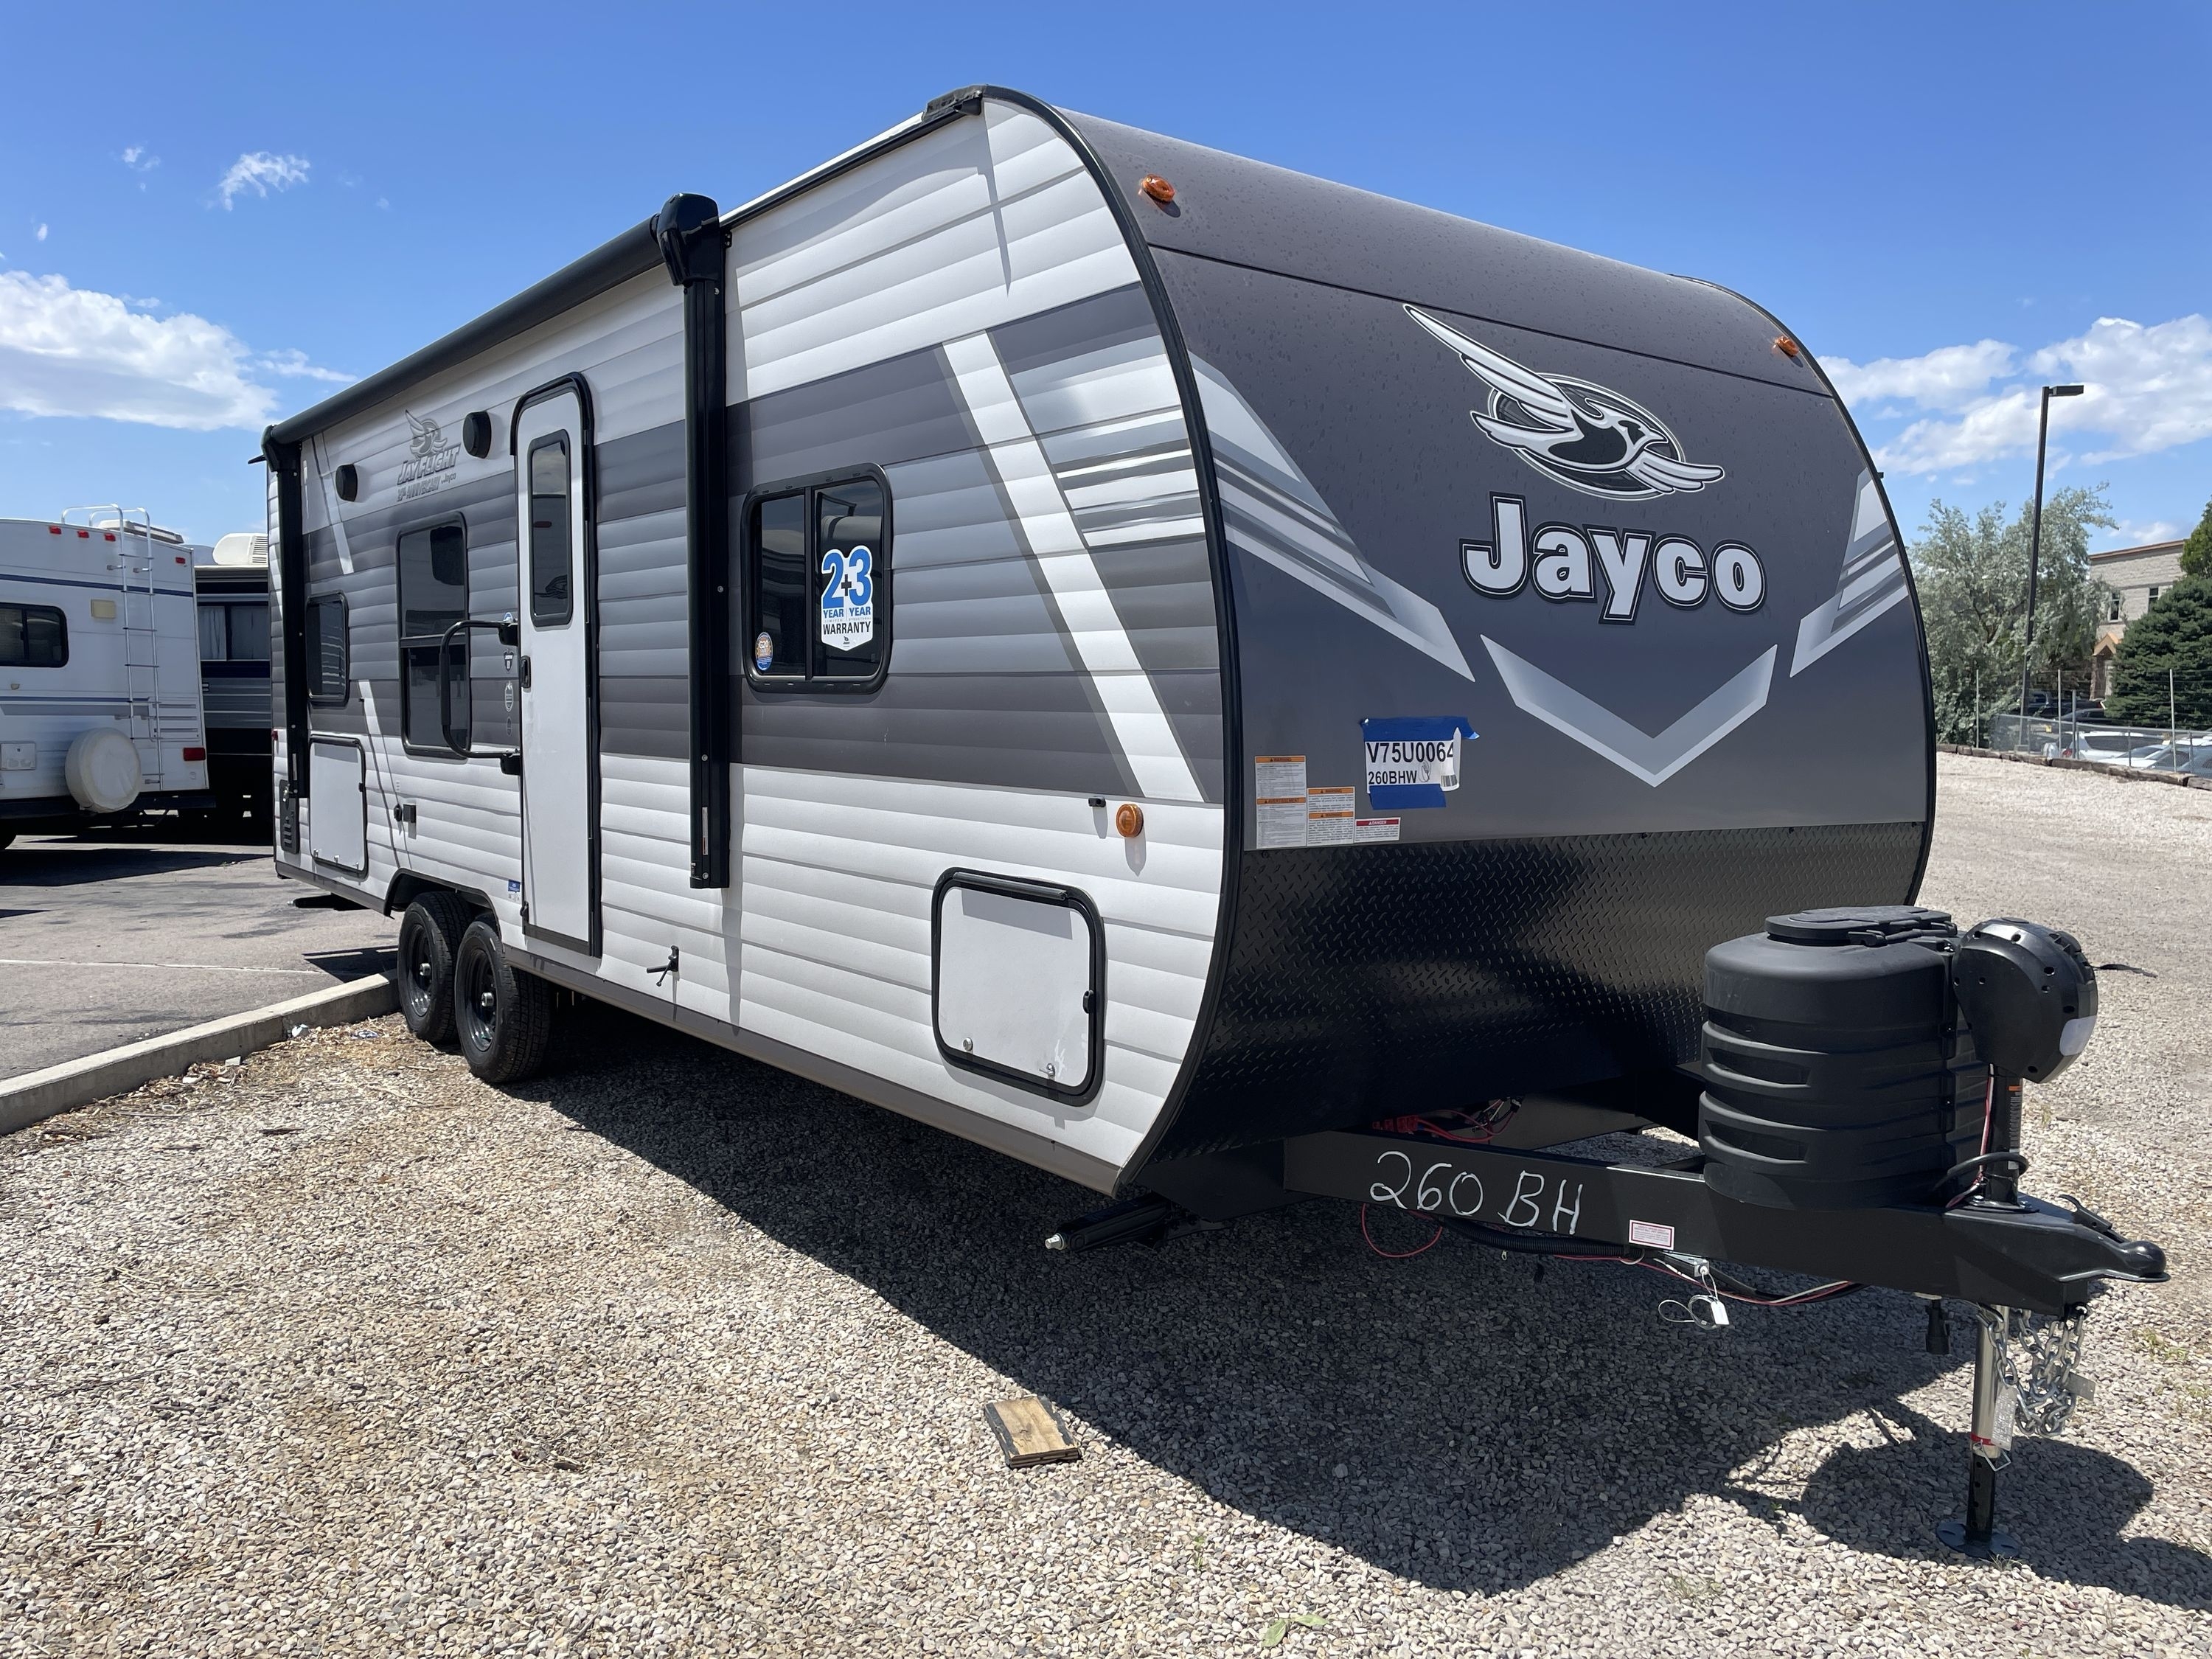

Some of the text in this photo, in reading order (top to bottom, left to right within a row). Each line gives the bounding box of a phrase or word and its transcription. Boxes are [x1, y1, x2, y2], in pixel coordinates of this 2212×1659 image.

[1461, 493, 1766, 624] Jayco
[823, 607, 871, 618] YEAR YEAR
[823, 621, 871, 635] WARRANTY
[1366, 742, 1453, 763] V75U0064
[1368, 771, 1416, 785] 260BHW
[1370, 1151, 1583, 1234] 260 BH
